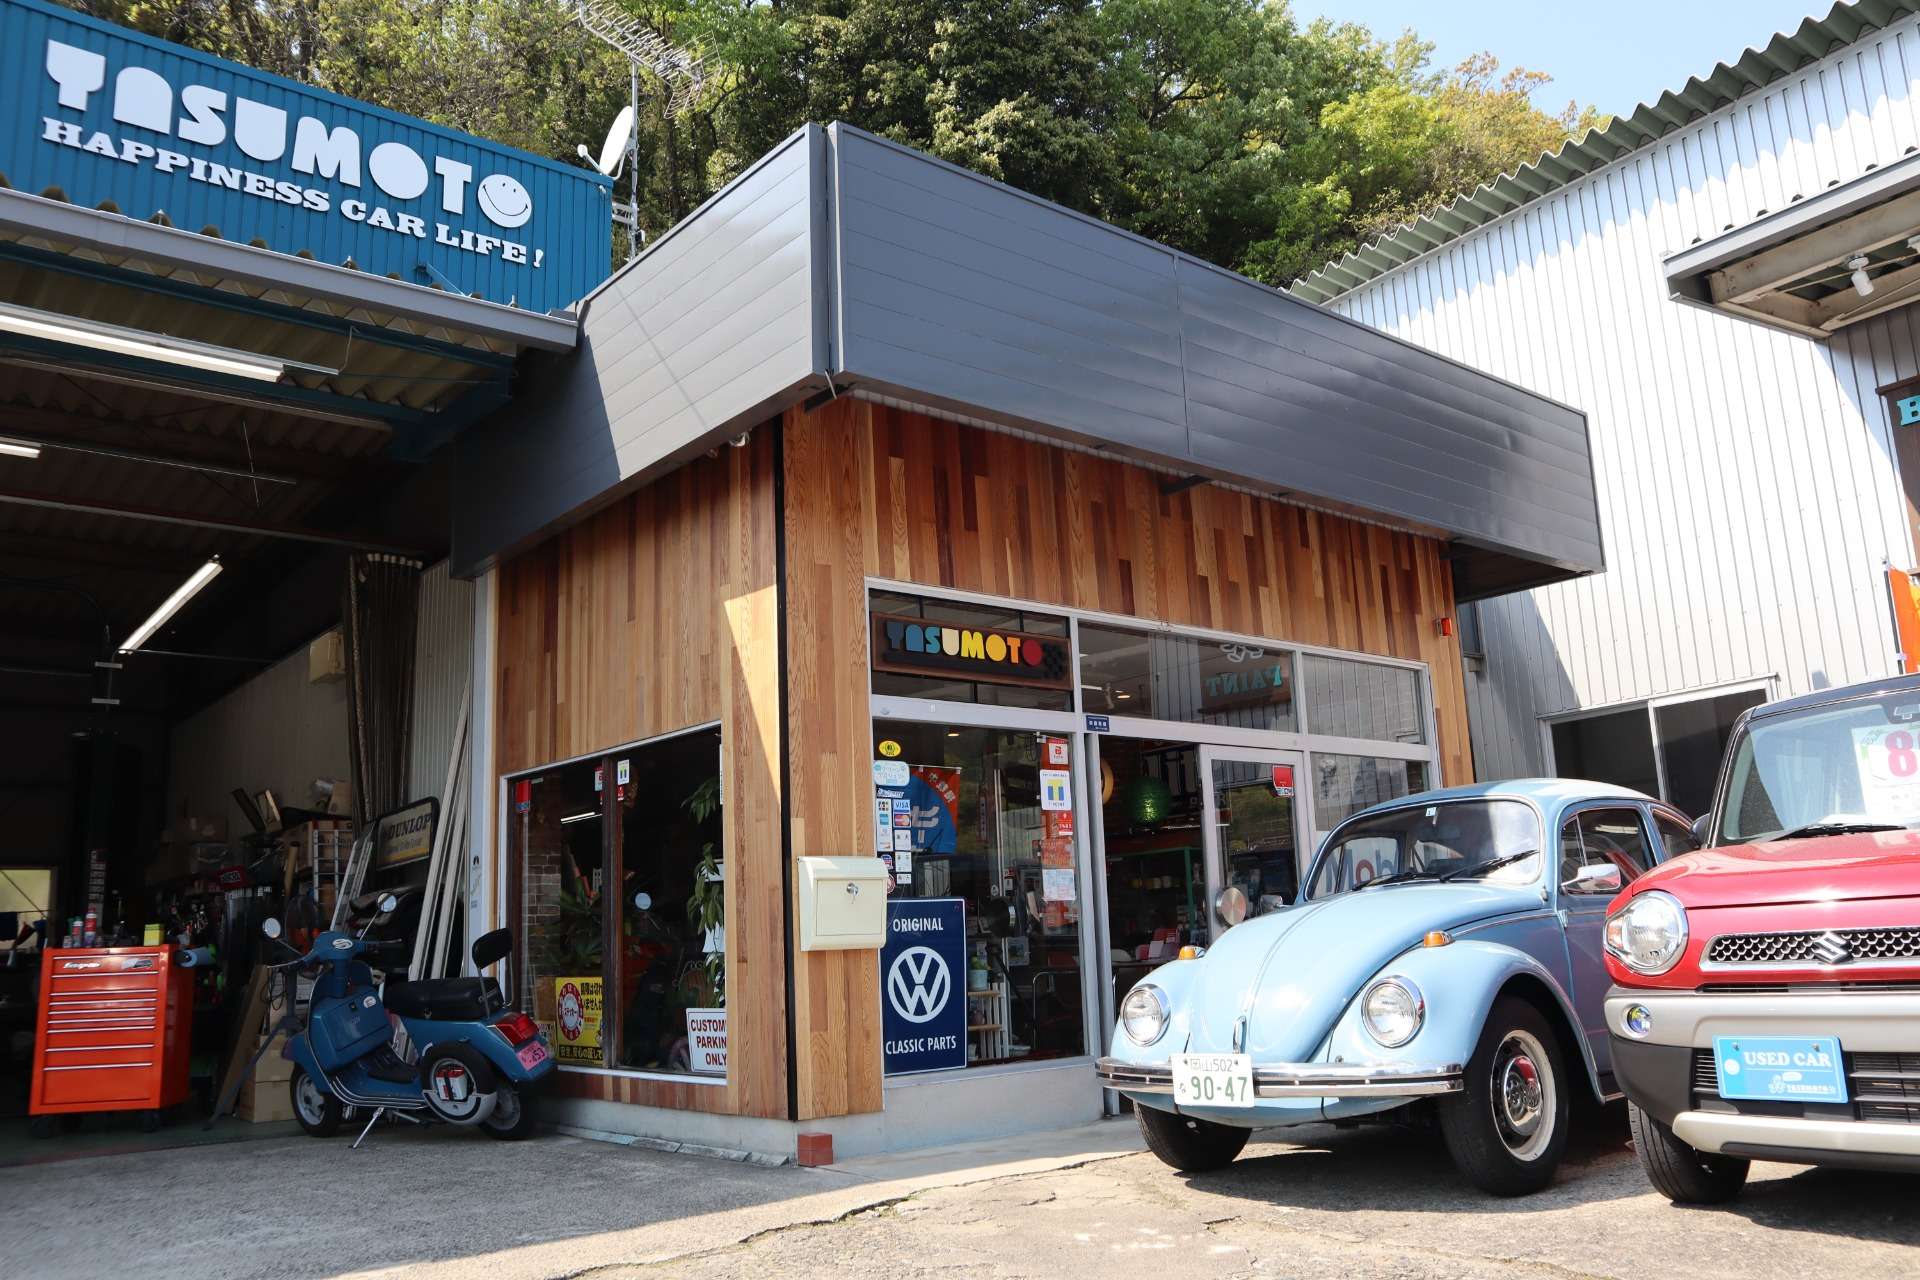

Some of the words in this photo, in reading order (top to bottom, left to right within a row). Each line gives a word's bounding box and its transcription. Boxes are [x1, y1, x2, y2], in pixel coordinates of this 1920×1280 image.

[46, 39, 532, 228] YASUMOTO
[42, 117, 331, 212] HAPPINESS
[341, 199, 426, 238] CAR
[886, 622, 1043, 666] YASUMOTO
[385, 812, 432, 840] DUNLOP
[892, 917, 944, 932] ORIGINAL
[885, 1038, 925, 1055] CLASSIC
[927, 1035, 957, 1051] PARTS
[705, 1052, 727, 1066] ONLY
[1743, 1051, 1790, 1066] USED
[1793, 1052, 1832, 1067] CAR
[1190, 1076, 1248, 1102] 90-47
